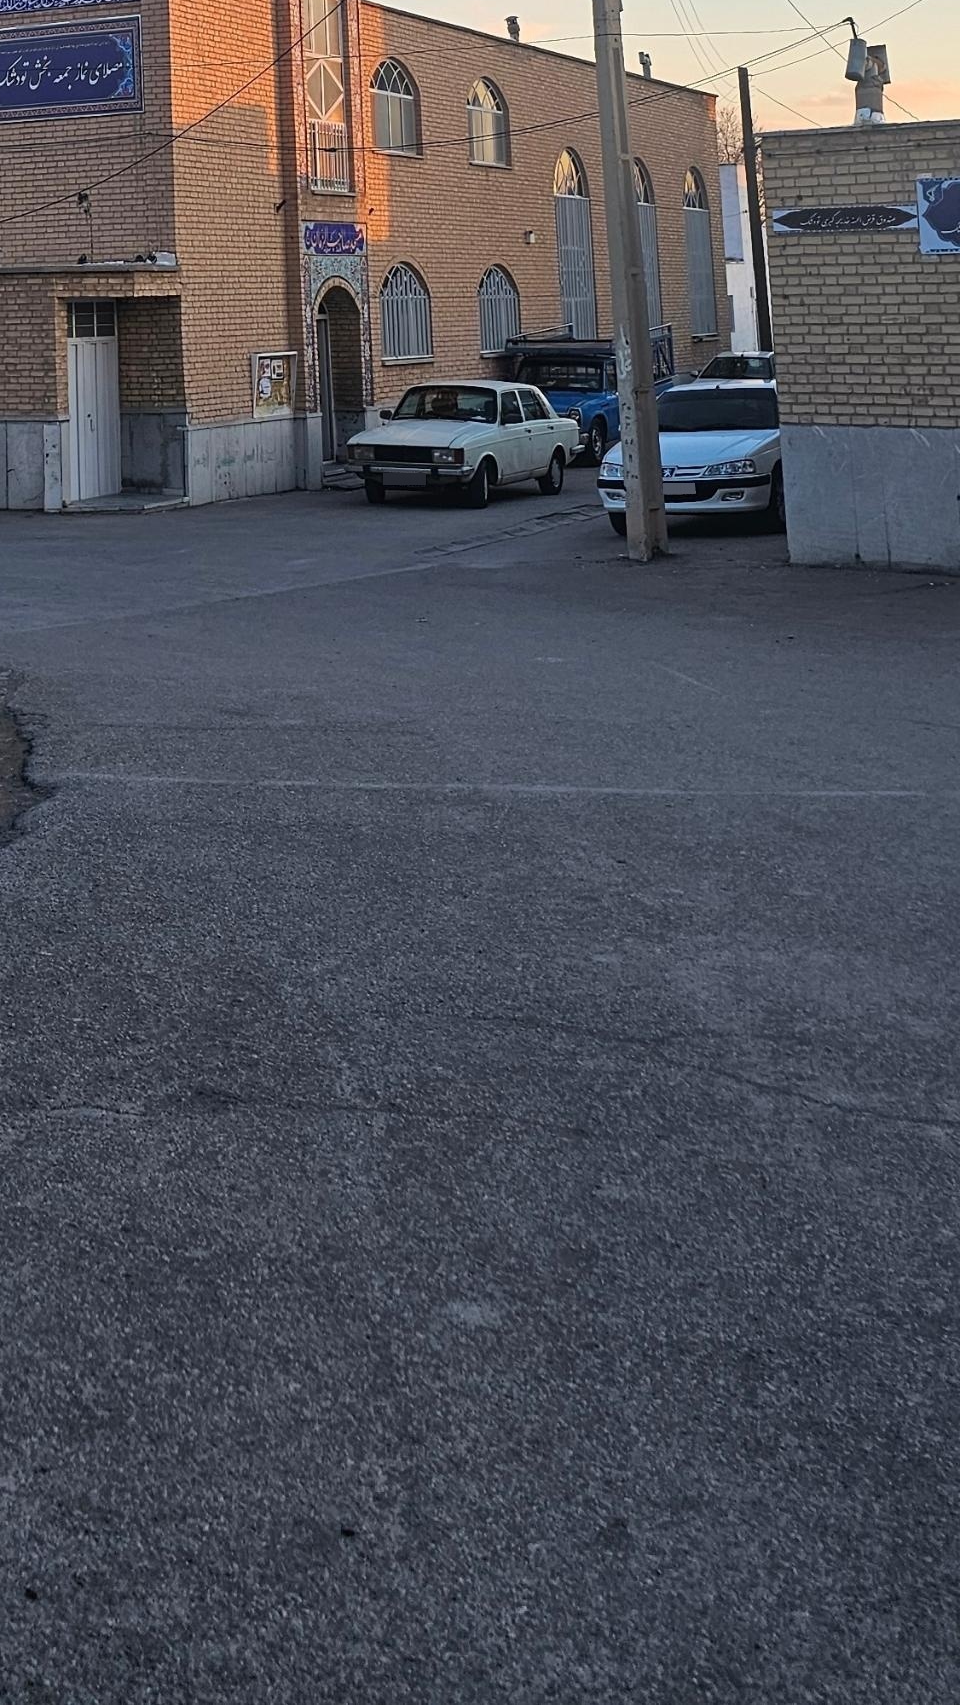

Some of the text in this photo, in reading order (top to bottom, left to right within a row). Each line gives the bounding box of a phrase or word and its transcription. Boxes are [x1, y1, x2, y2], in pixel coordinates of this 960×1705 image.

[28, 55, 52, 90] بخش
[53, 66, 72, 90] جمعه
[73, 61, 89, 81] نماز
[88, 62, 122, 85] مصلای
